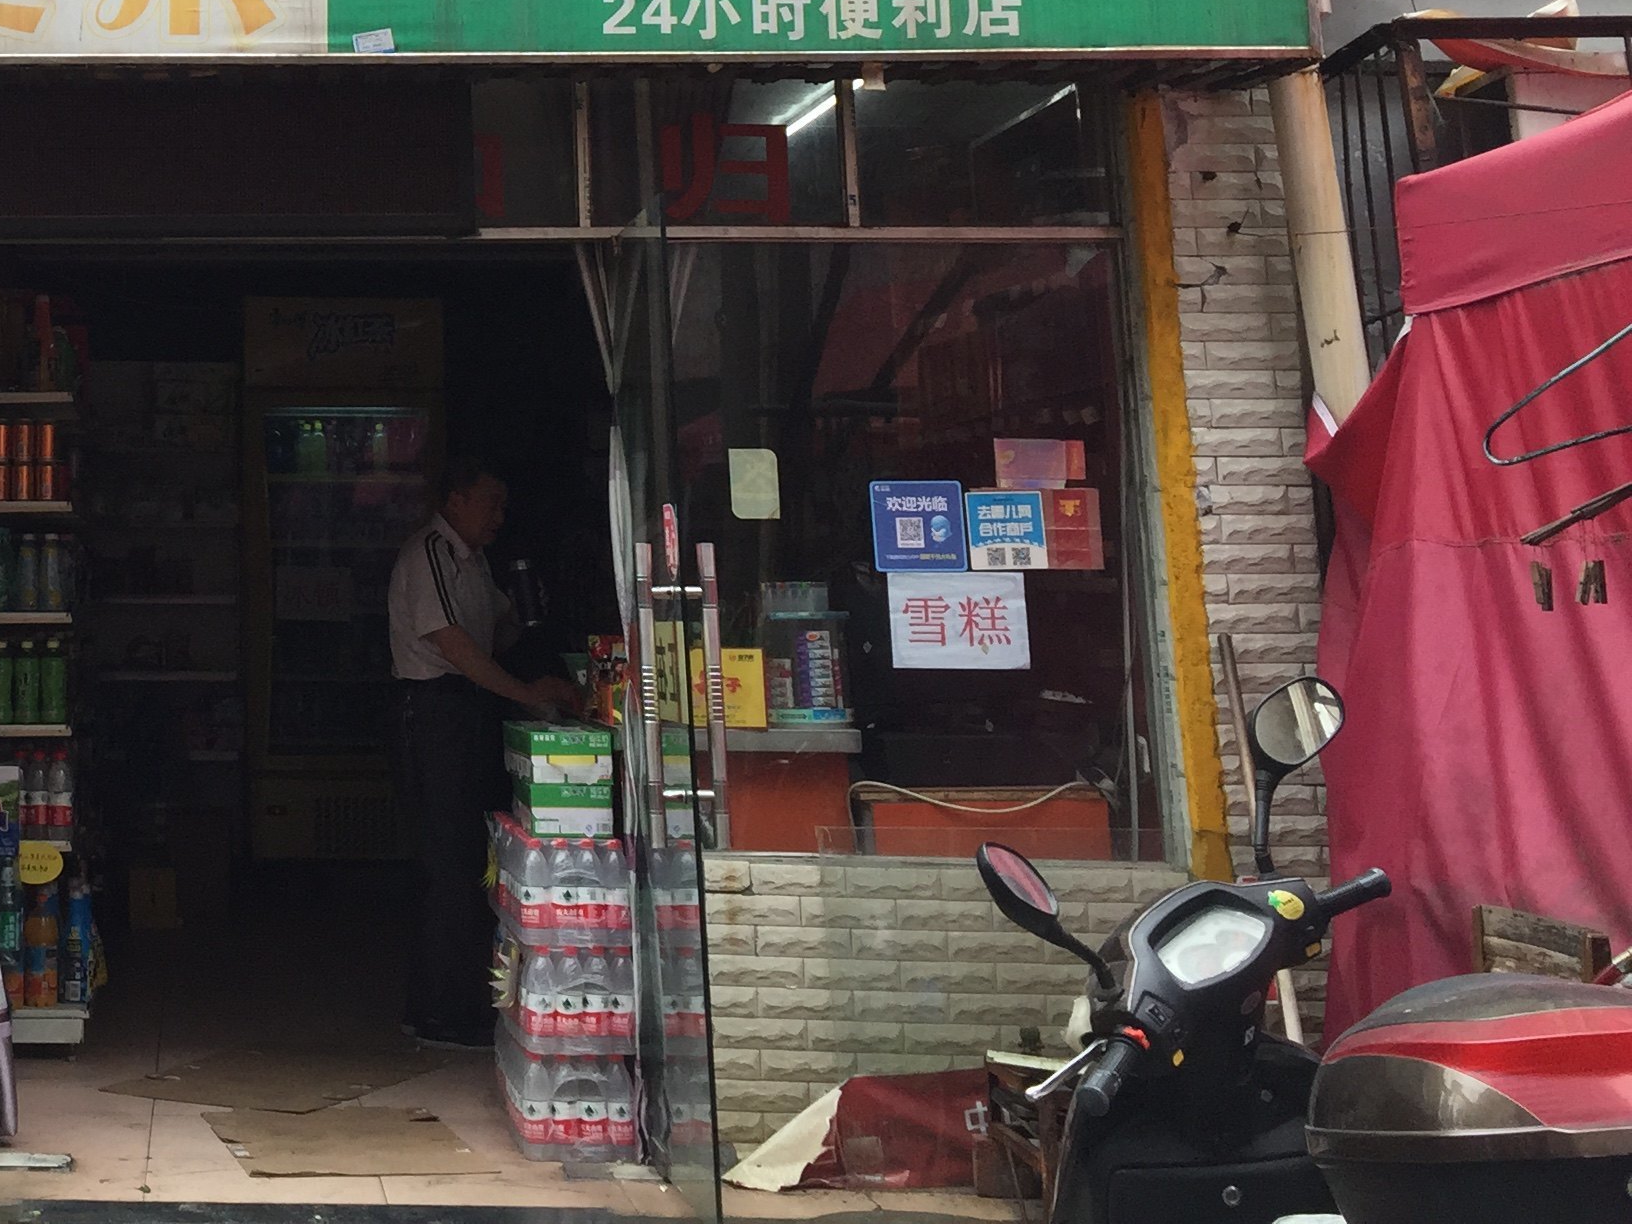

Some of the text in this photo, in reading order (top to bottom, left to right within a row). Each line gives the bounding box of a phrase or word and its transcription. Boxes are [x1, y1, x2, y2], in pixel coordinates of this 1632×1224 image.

[885, 495, 949, 513] 欢迎光临
[901, 595, 1013, 648] 雪糕
